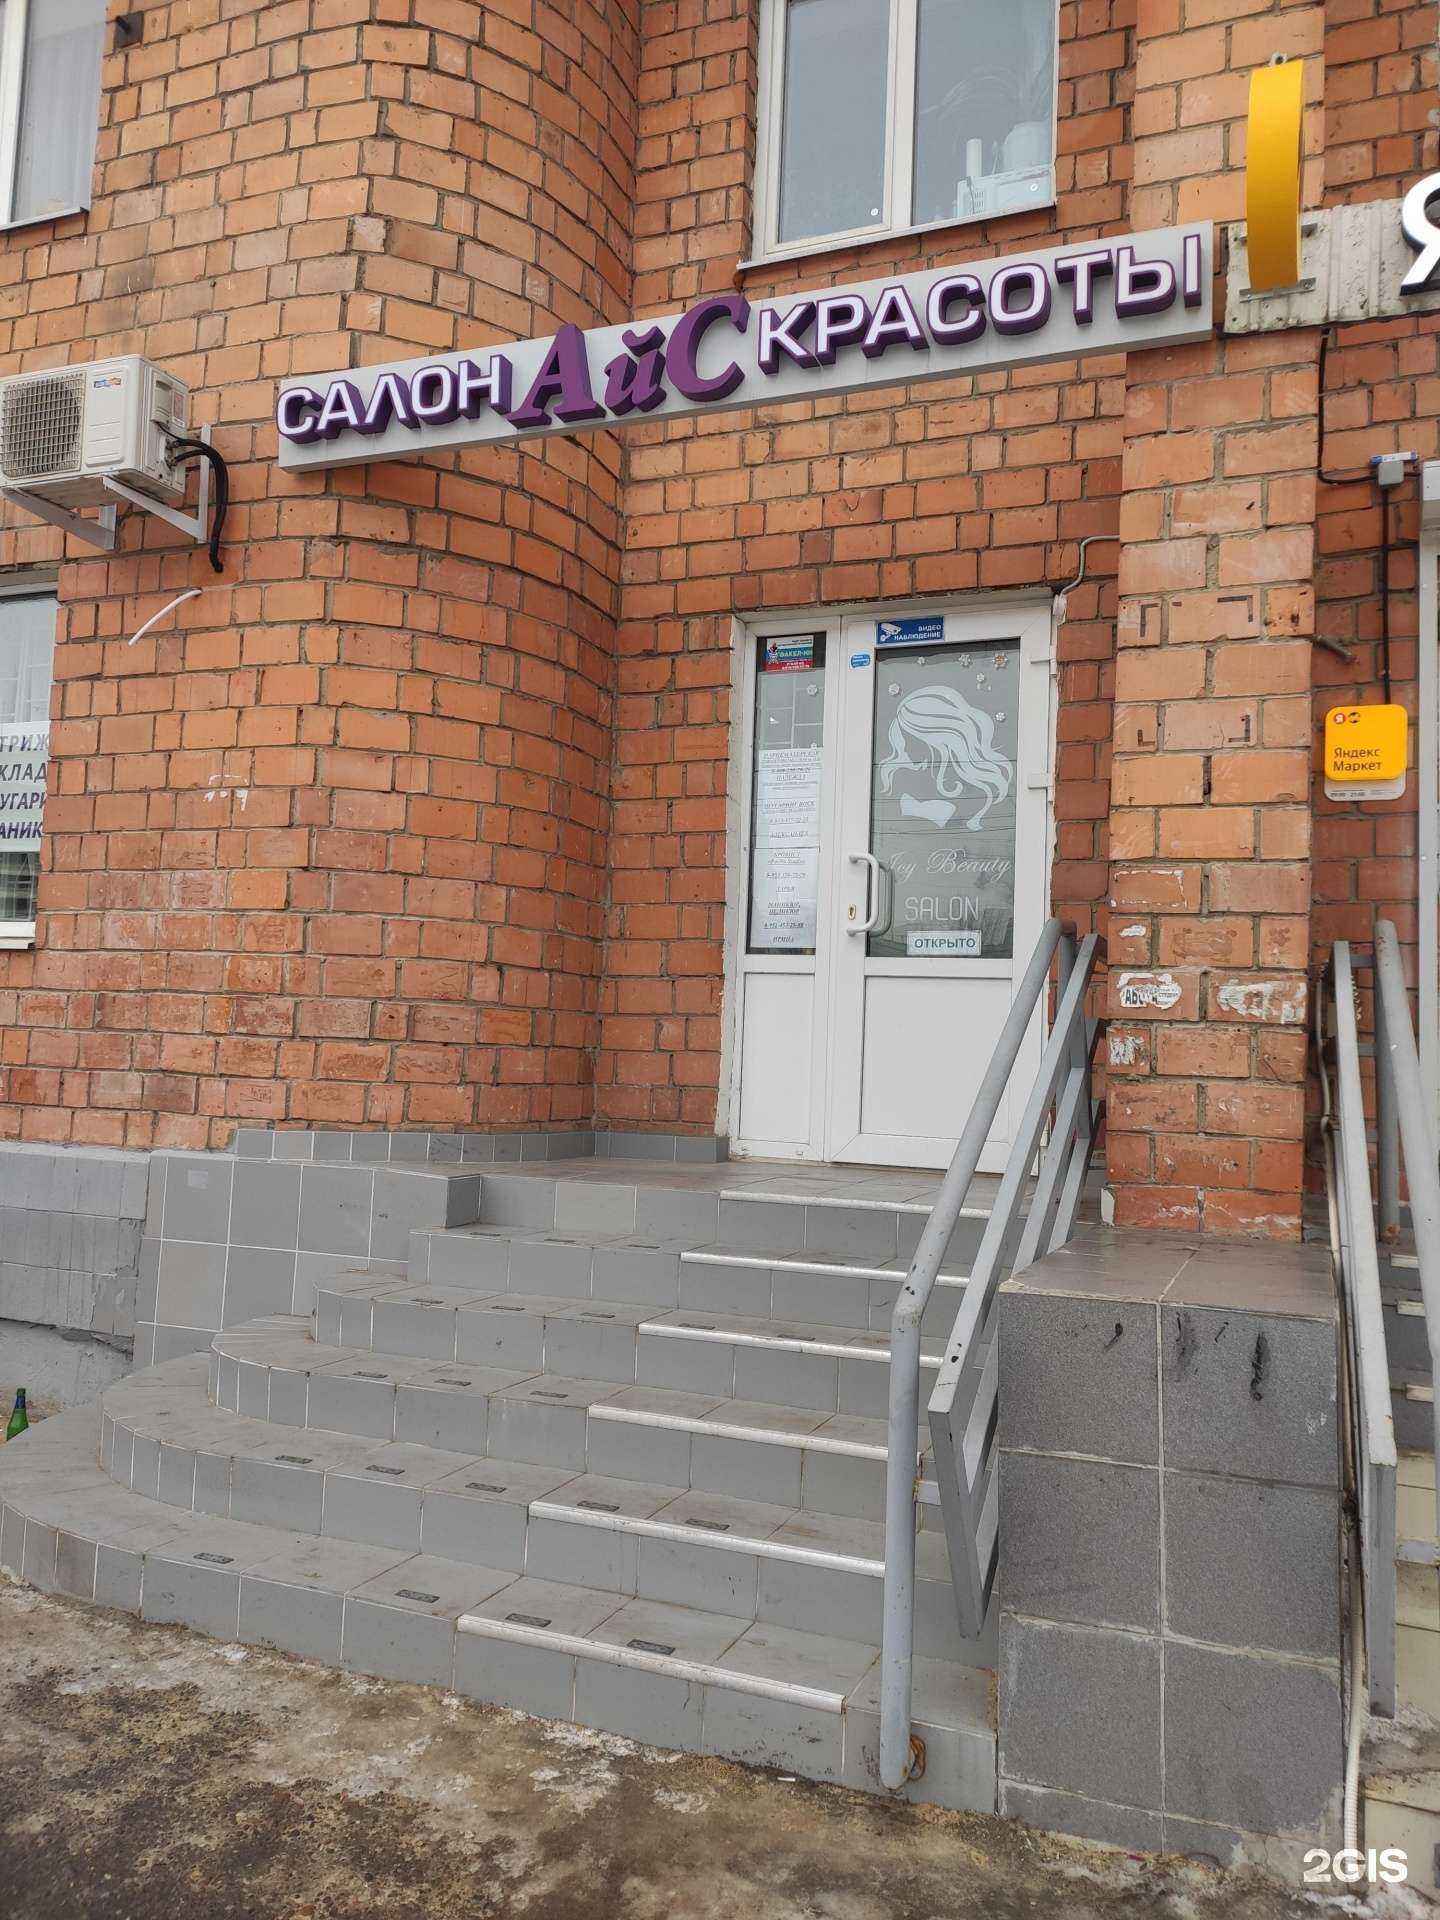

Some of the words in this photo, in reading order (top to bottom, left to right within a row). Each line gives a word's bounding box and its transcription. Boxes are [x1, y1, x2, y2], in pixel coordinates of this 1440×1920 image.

[277, 354, 511, 444] САЛОН
[508, 293, 751, 428] АйС
[758, 234, 1202, 375] КРАСОТЫ
[918, 624, 942, 632] ВИДЕО
[894, 631, 941, 641] НАБЛЮДЕНИЕ
[1334, 746, 1380, 760] Яндекс
[1333, 761, 1383, 773] Маркет
[926, 848, 1010, 881] Beauty
[904, 896, 979, 921] SALON
[914, 938, 976, 949] ОТКРЫТО
